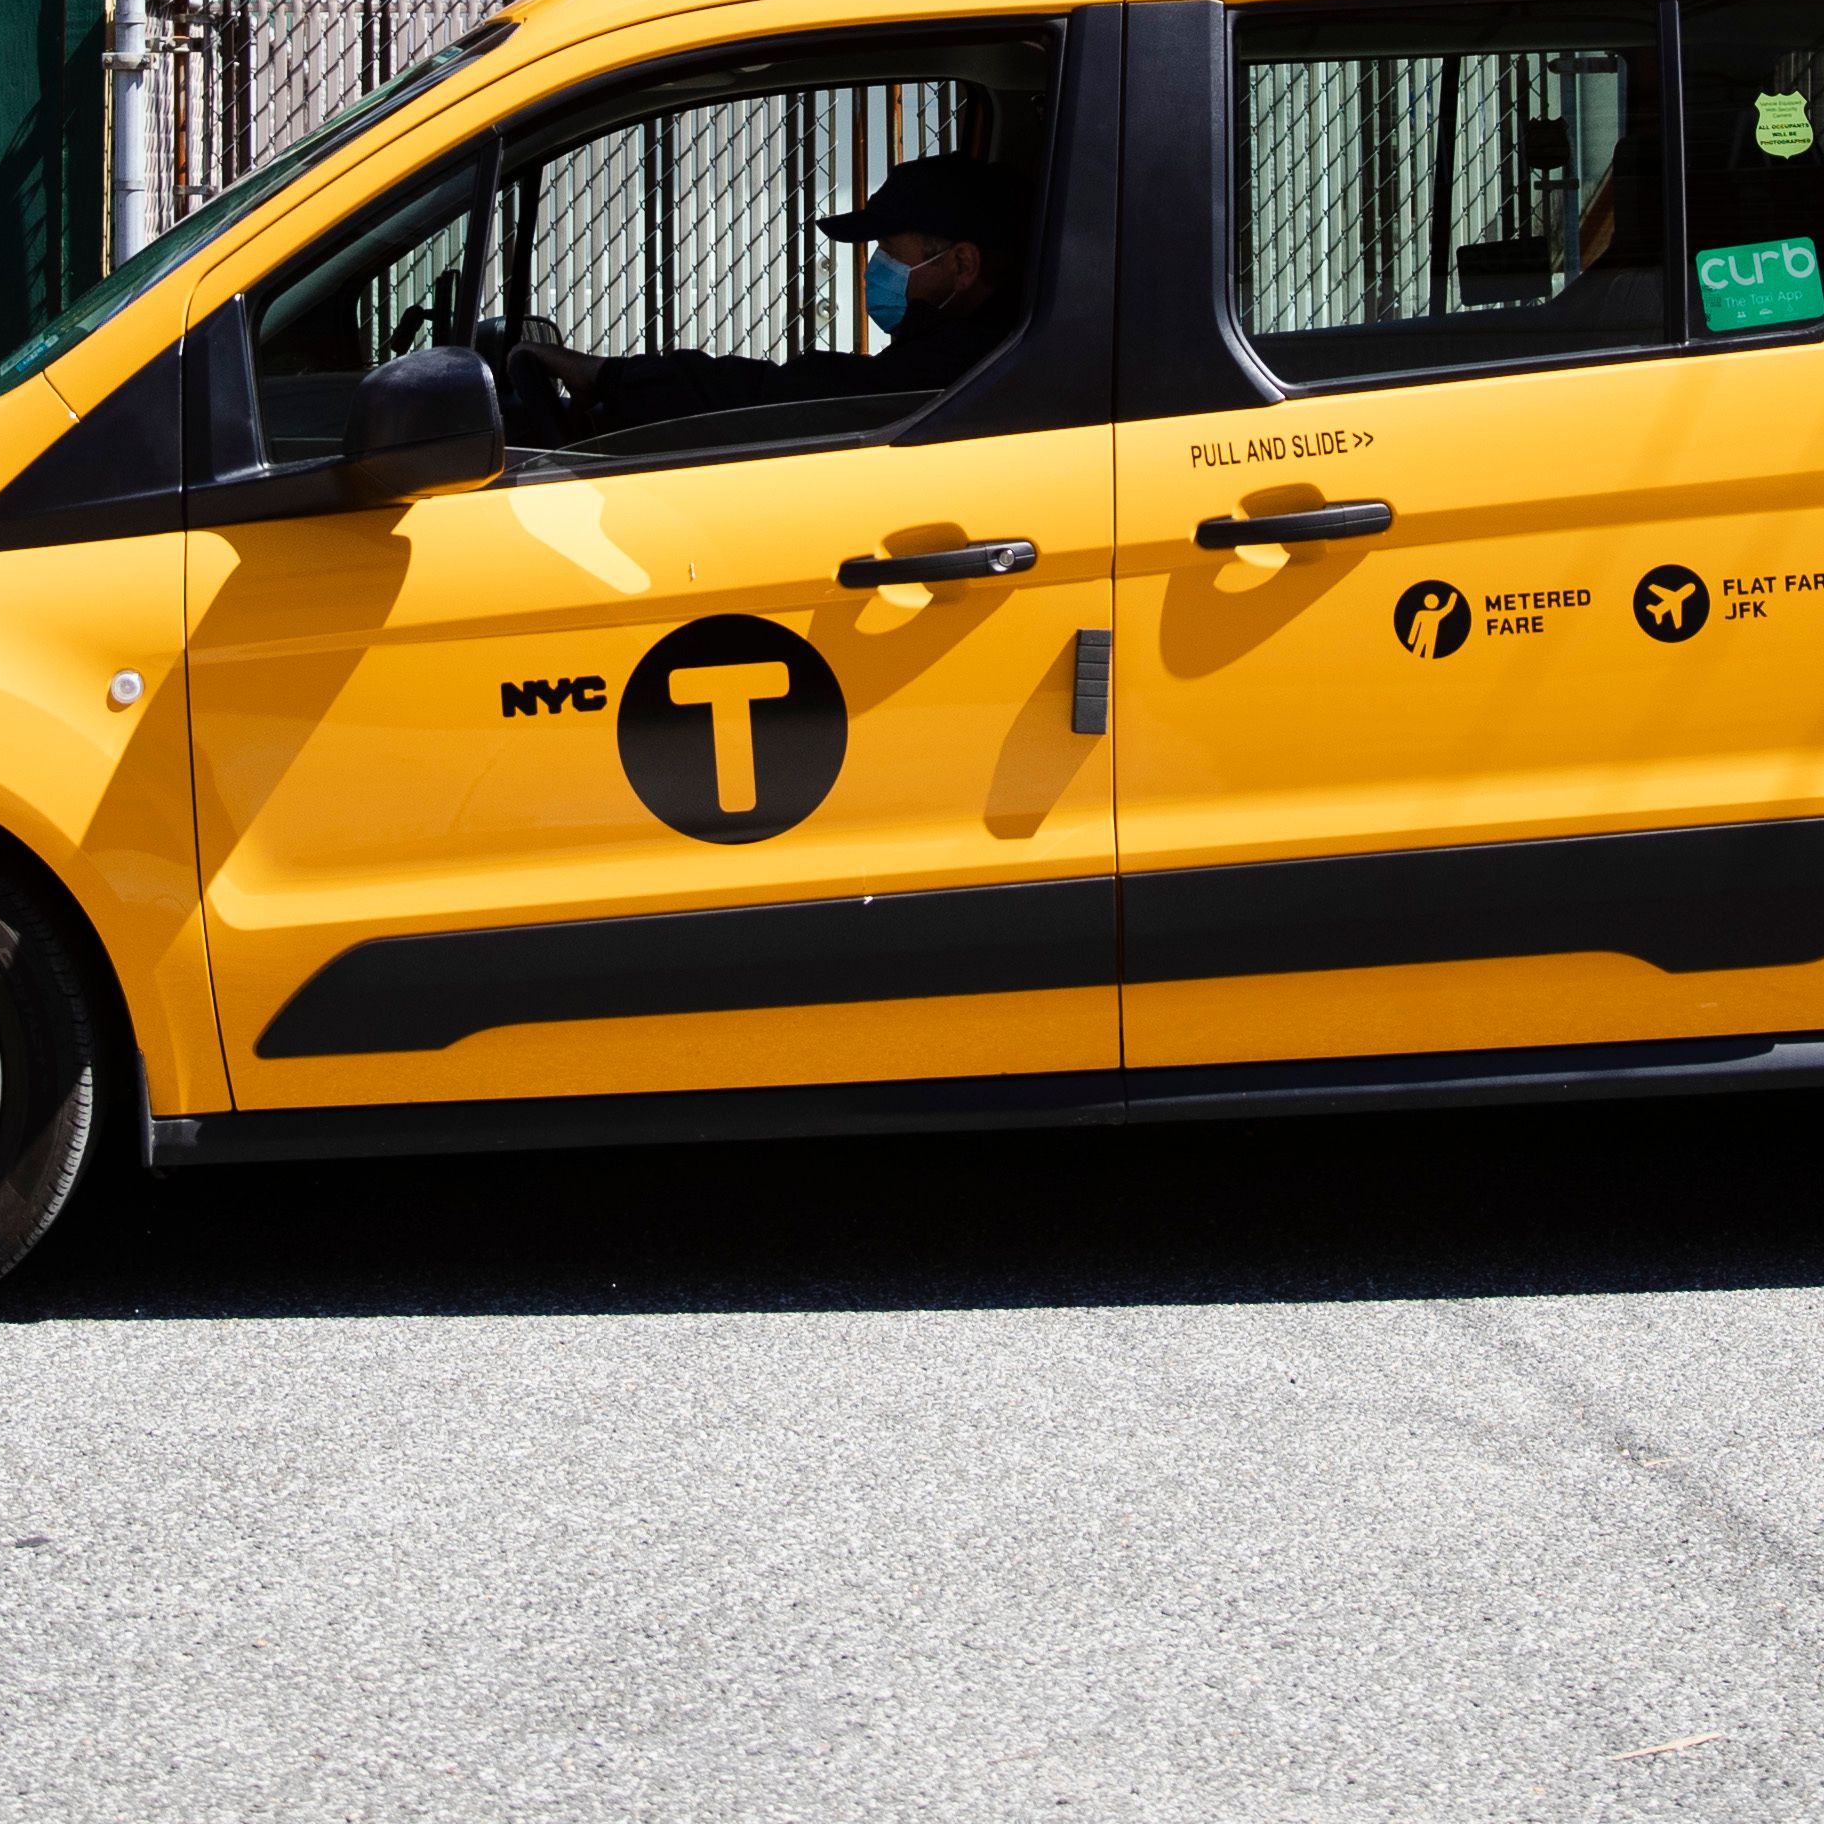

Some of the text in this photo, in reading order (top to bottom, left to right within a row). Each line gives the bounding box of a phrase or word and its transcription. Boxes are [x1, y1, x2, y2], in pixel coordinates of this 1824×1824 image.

[1700, 242, 1815, 289] curb
[1725, 290, 1803, 309] The Taxi App
[1191, 430, 1348, 468] PULL AND SLIDE
[1723, 576, 1776, 596] FLAT
[1485, 589, 1591, 612] METERED
[1725, 600, 1767, 620] JFK
[1487, 615, 1544, 636] FARE
[501, 676, 607, 718] NYC
[668, 661, 790, 813] T
